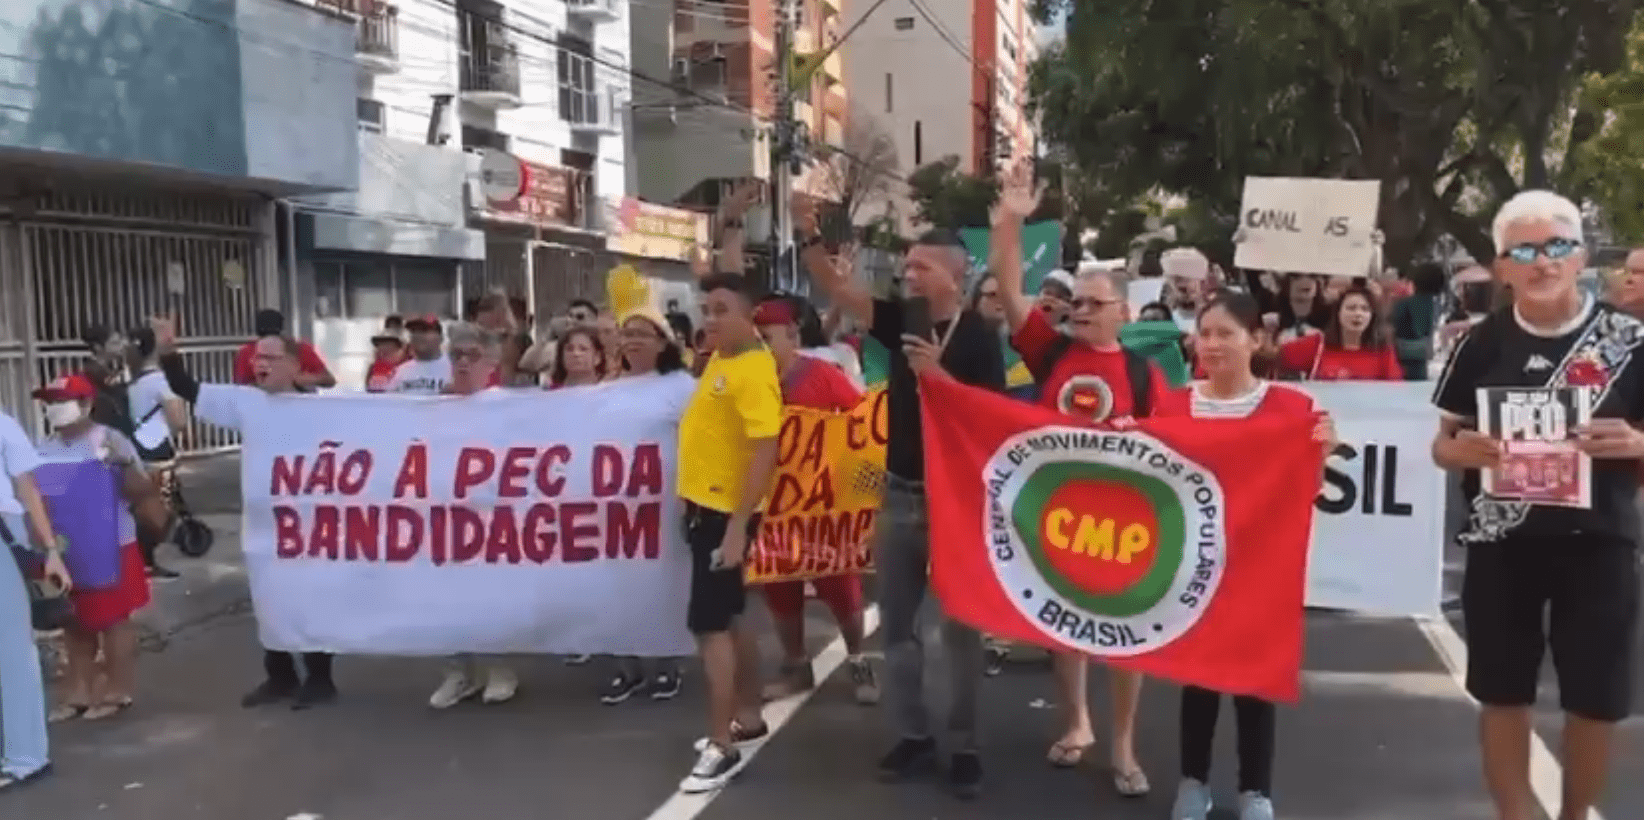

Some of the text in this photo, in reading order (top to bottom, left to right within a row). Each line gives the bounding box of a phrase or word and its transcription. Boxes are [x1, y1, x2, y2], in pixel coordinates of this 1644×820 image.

[270, 440, 373, 497] NÃO
[454, 445, 572, 498] PEC
[592, 442, 663, 498] DA
[767, 465, 835, 517] DA
[272, 502, 661, 566] BANDIDAGEM
[1007, 444, 1031, 466] DE
[1027, 432, 1185, 476] MOVIMENTOS
[1179, 472, 1217, 608] POPULARES
[1045, 507, 1150, 564] CMP
[1037, 599, 1147, 647] BRASIL
